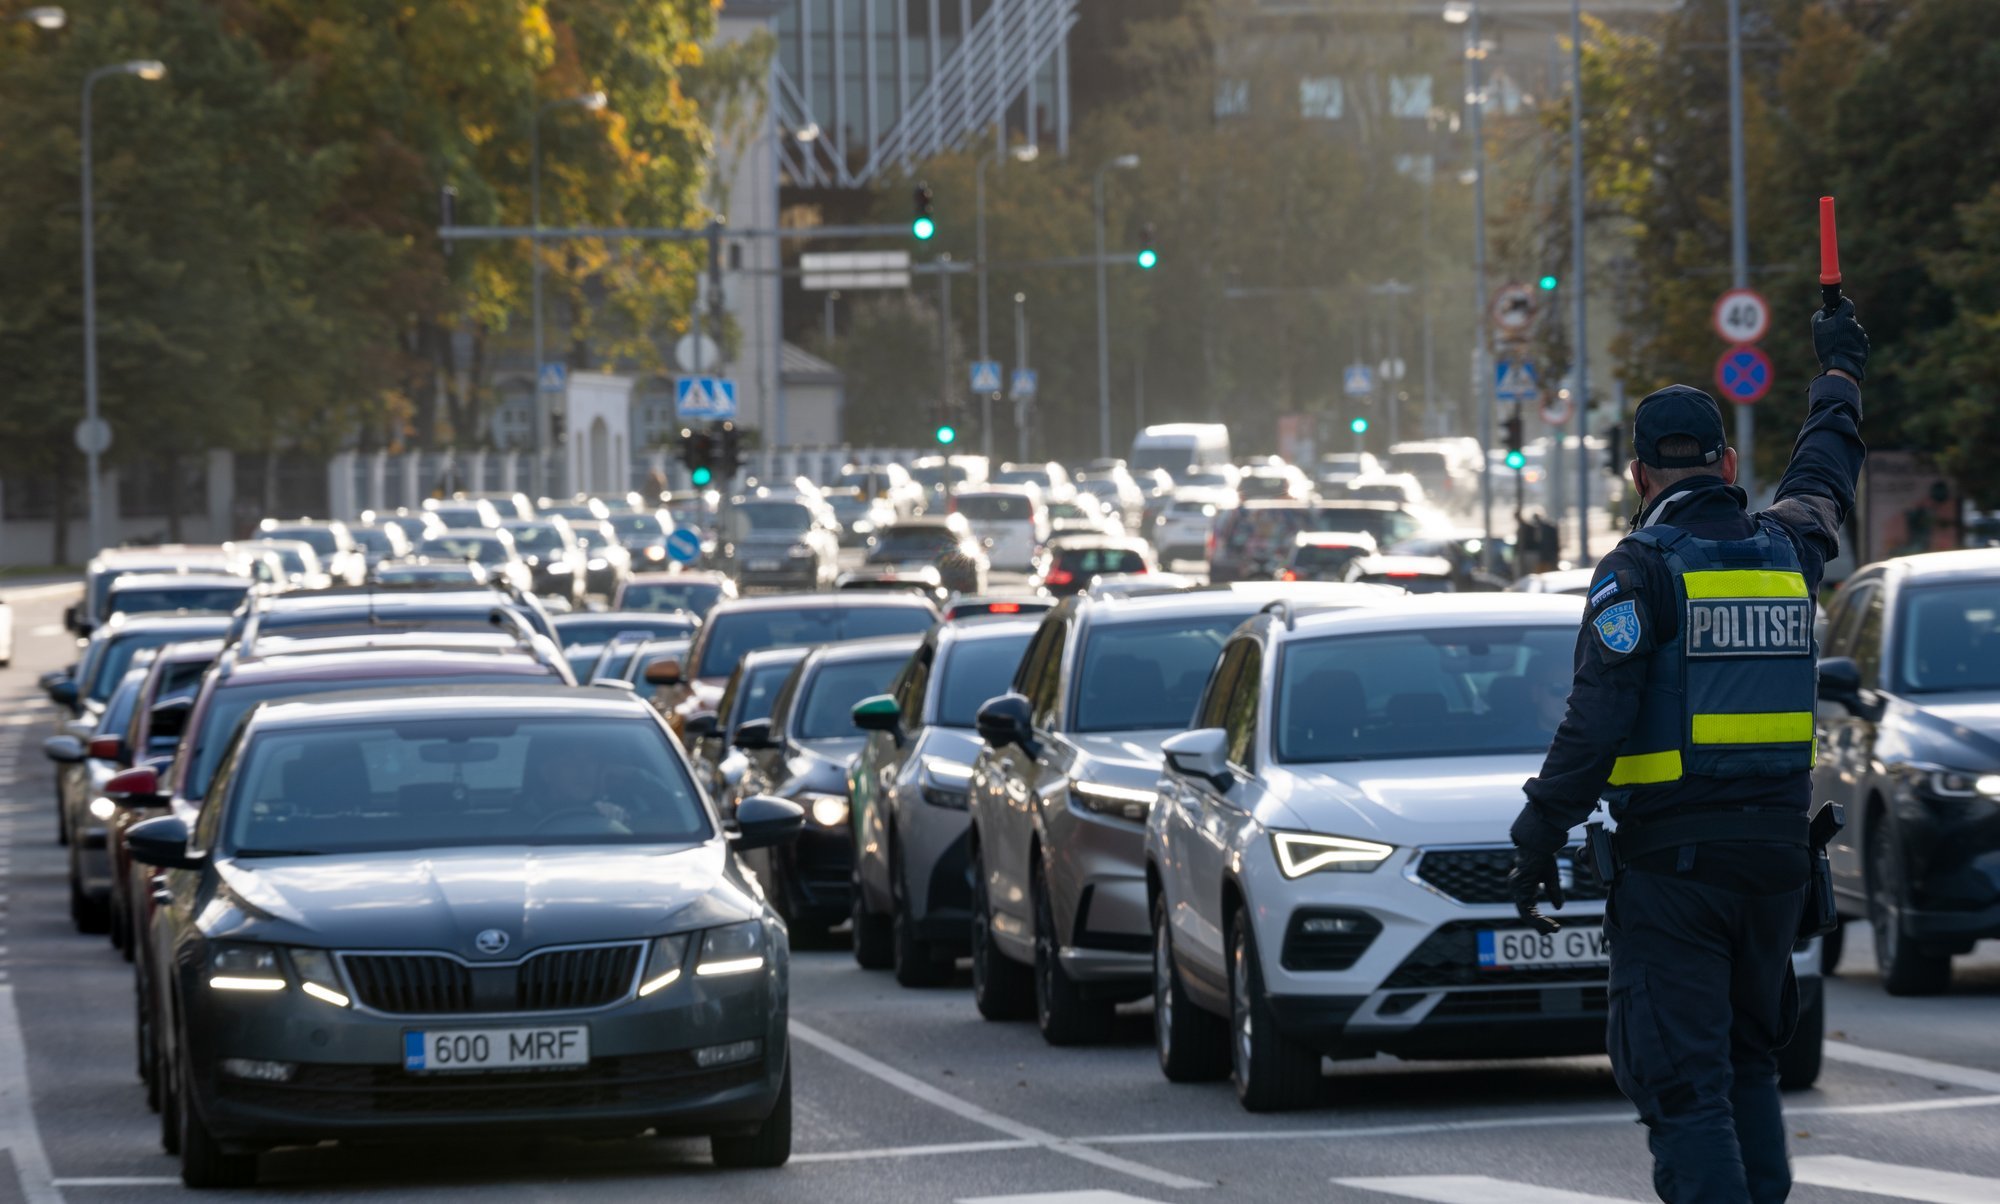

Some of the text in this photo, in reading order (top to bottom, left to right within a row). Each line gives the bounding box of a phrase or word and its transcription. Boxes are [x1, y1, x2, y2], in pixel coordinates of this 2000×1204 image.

[1726, 304, 1758, 330] 40
[1598, 604, 1632, 624] POLITSEI
[1693, 605, 1807, 648] POLITSEI
[1503, 933, 1554, 960] 608
[435, 1029, 579, 1063] 600 MRF
